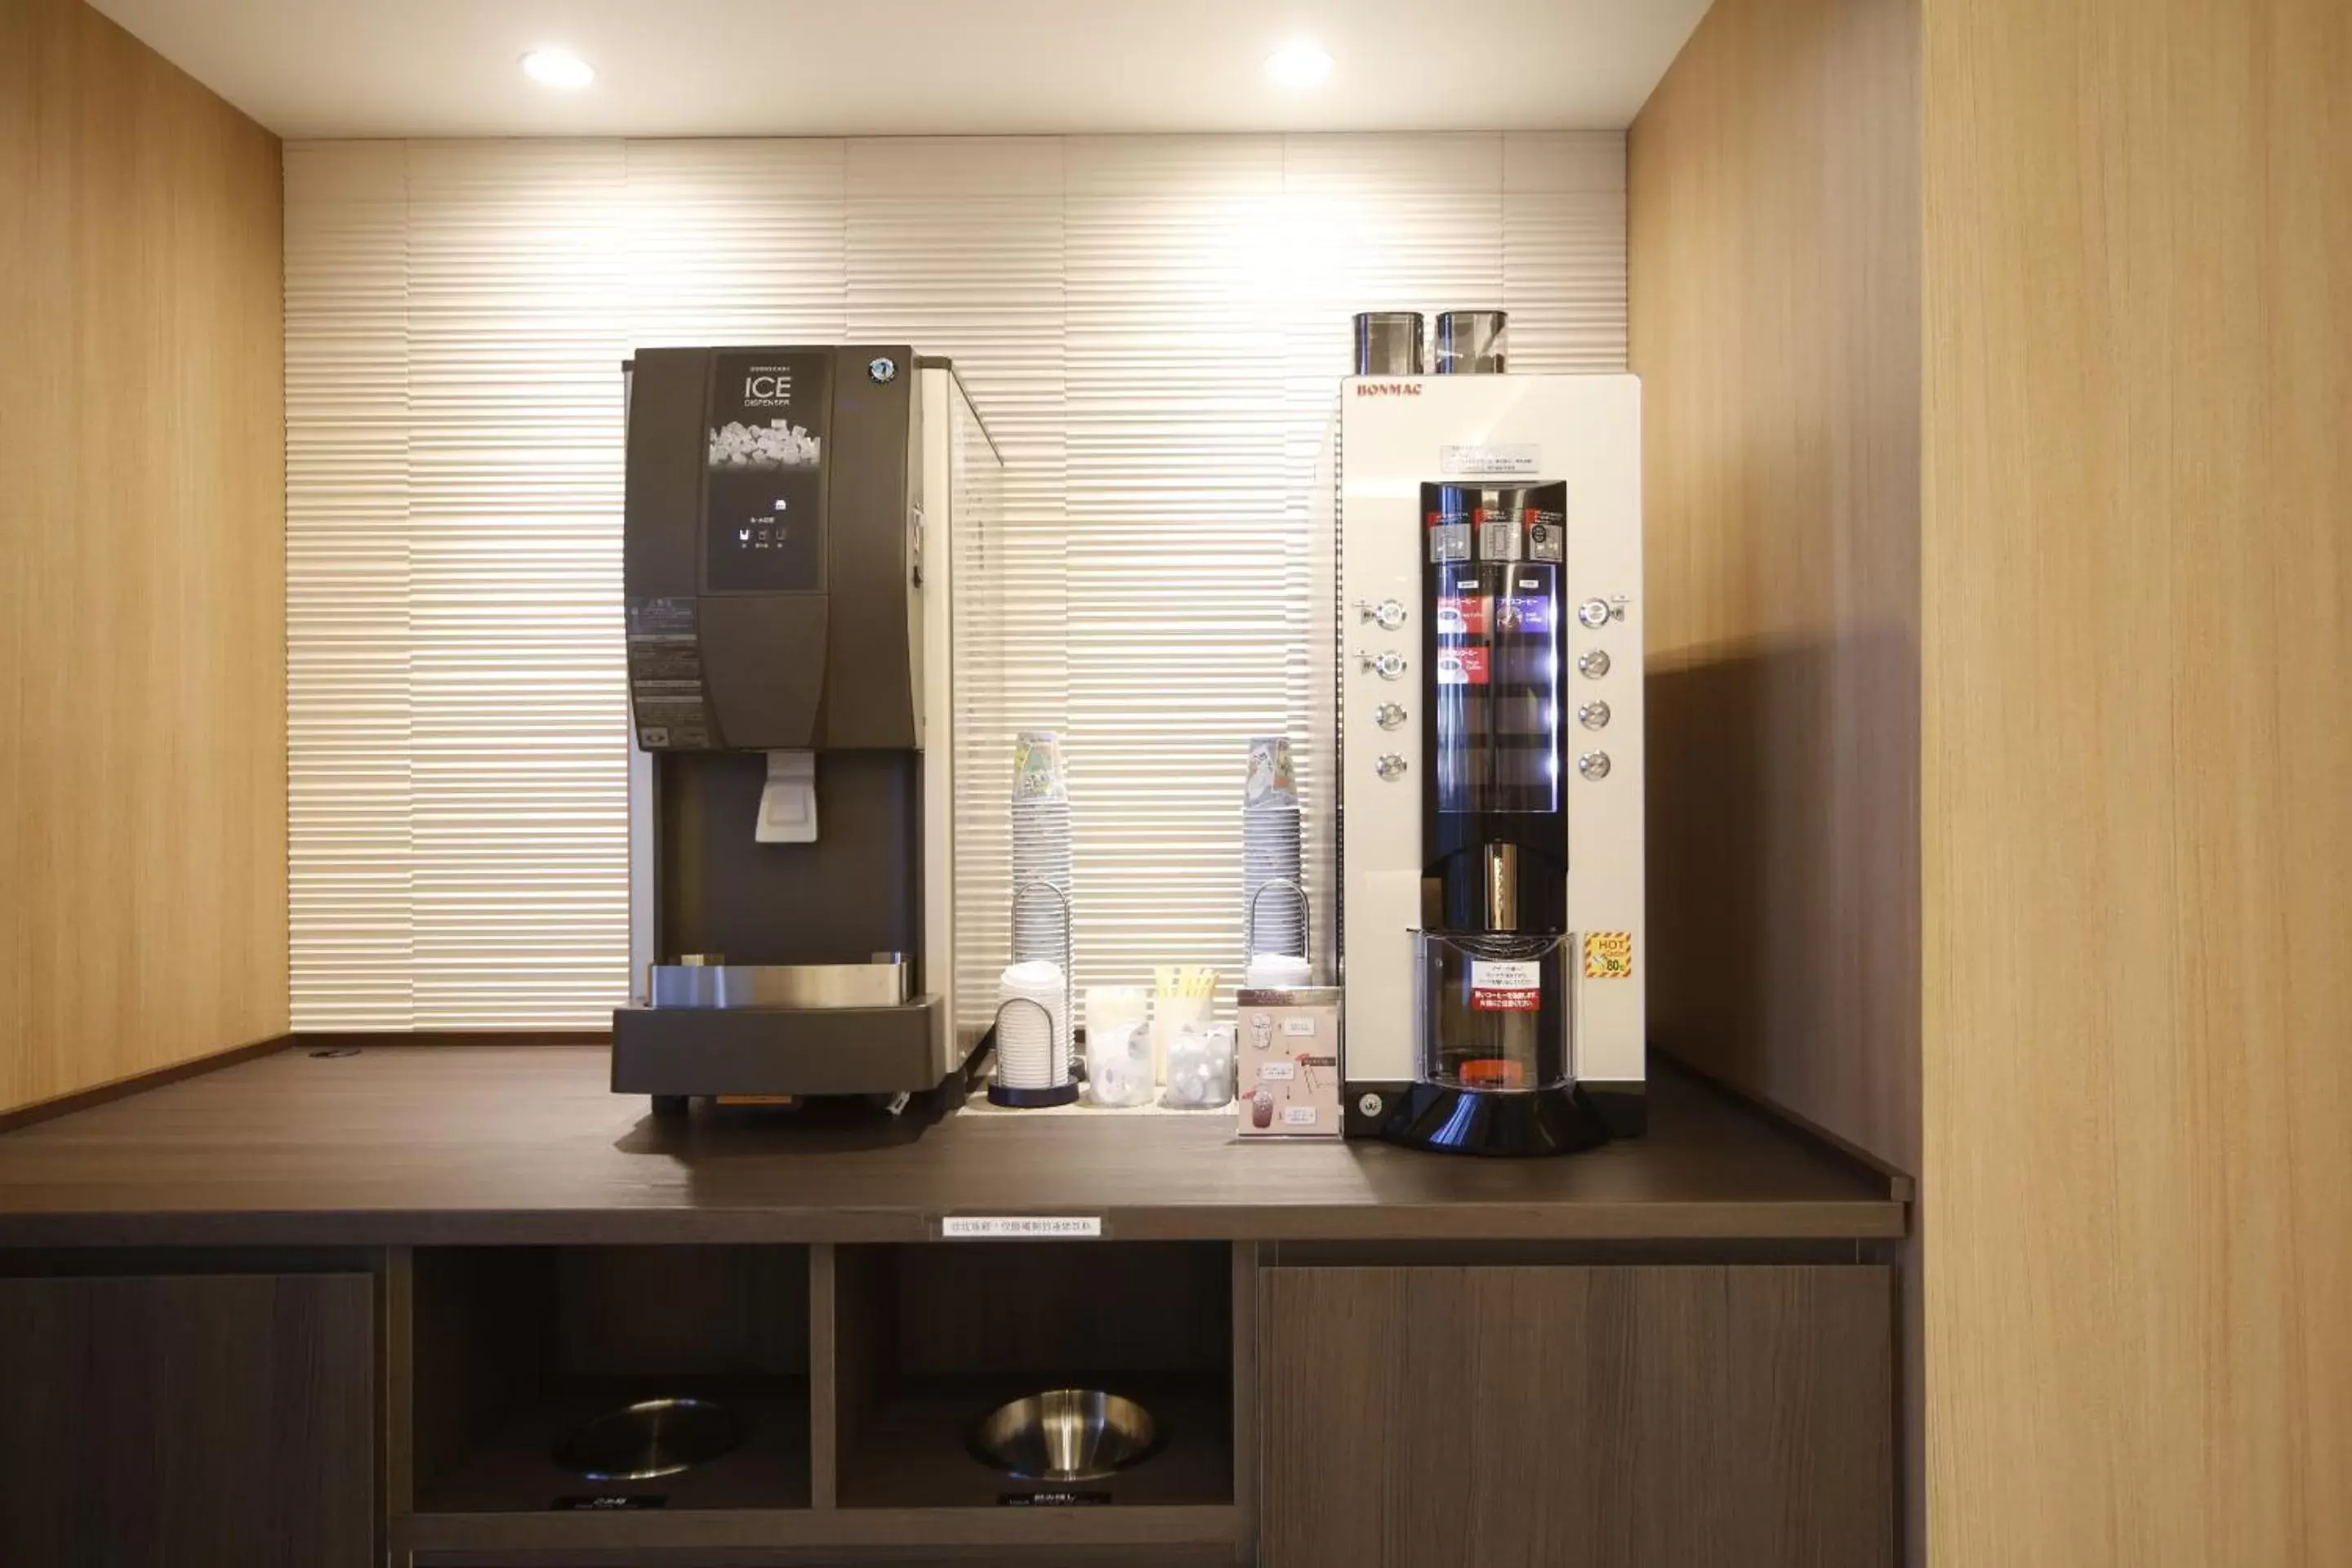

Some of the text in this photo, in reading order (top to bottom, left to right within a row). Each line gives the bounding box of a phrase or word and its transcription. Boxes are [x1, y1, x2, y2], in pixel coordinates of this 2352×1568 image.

[745, 376, 791, 398] ICE
[1357, 383, 1422, 397] BONMAC
[1599, 940, 1625, 950] HOT
